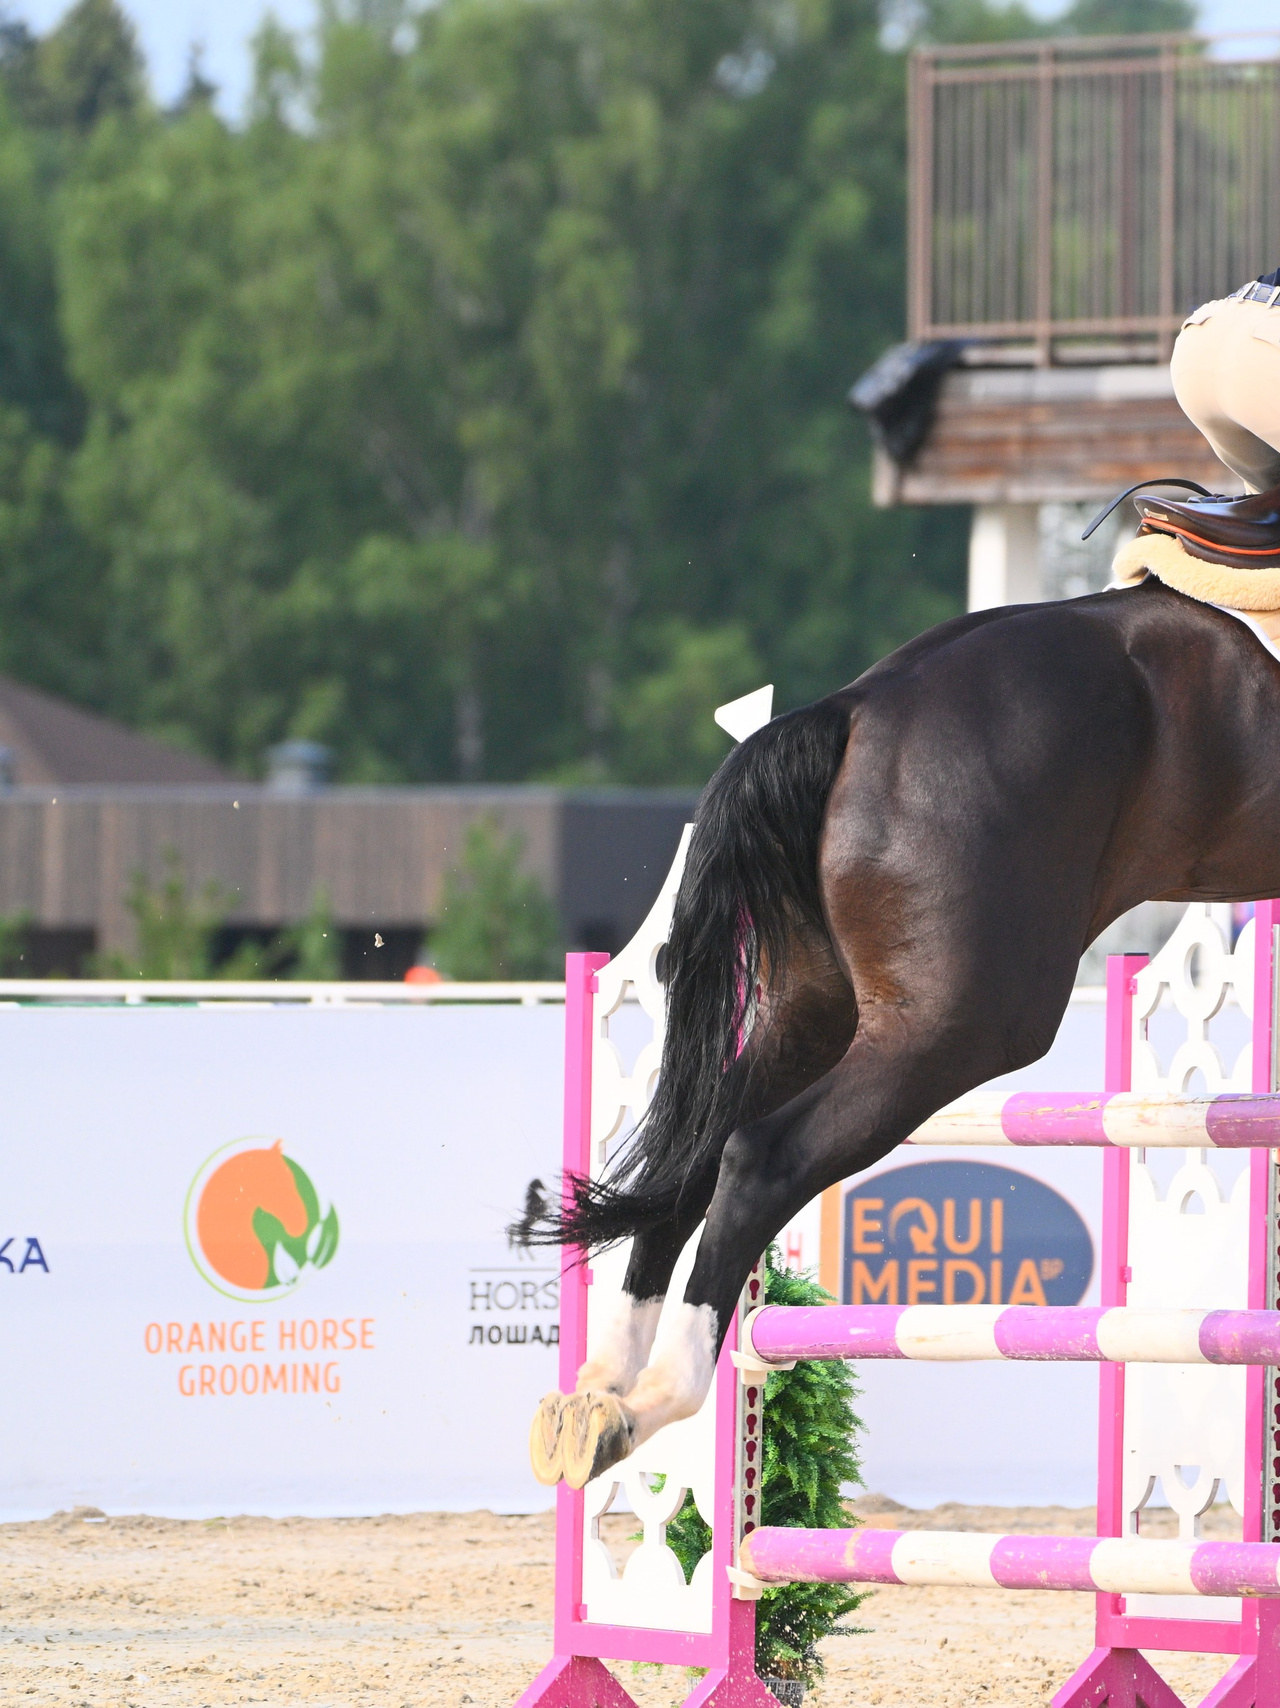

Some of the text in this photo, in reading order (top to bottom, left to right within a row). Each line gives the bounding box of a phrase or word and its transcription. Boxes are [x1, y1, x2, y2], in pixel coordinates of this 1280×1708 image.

[853, 1197, 1004, 1254] EQUI
[852, 1258, 1049, 1305] MEDIA
[143, 1317, 377, 1354] ORANGE HORSE
[177, 1360, 342, 1397] GROOMING
